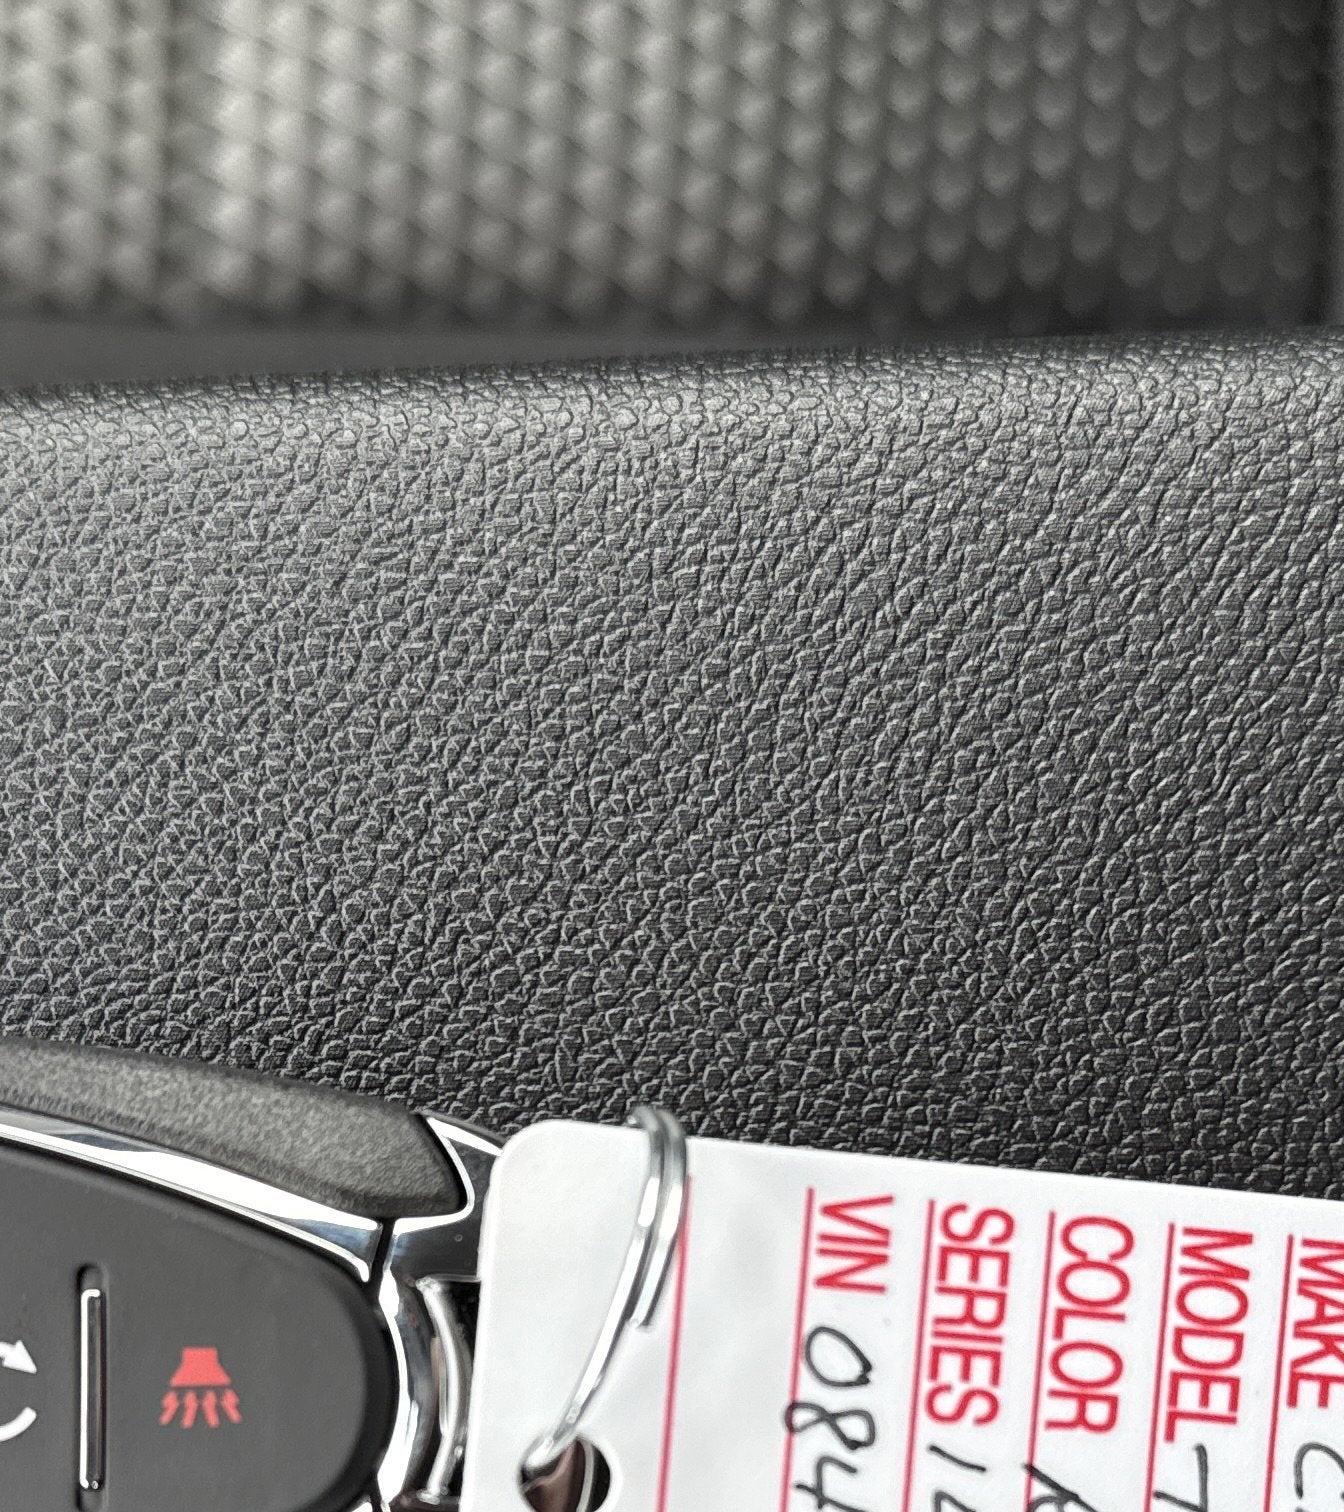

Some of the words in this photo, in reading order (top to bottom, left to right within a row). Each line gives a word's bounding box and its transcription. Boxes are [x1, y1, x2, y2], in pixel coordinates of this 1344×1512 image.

[814, 1194, 895, 1294] VIN
[923, 1202, 1016, 1426] SERIES
[1044, 1214, 1136, 1434] COLOR
[1164, 1226, 1255, 1444] MODEL
